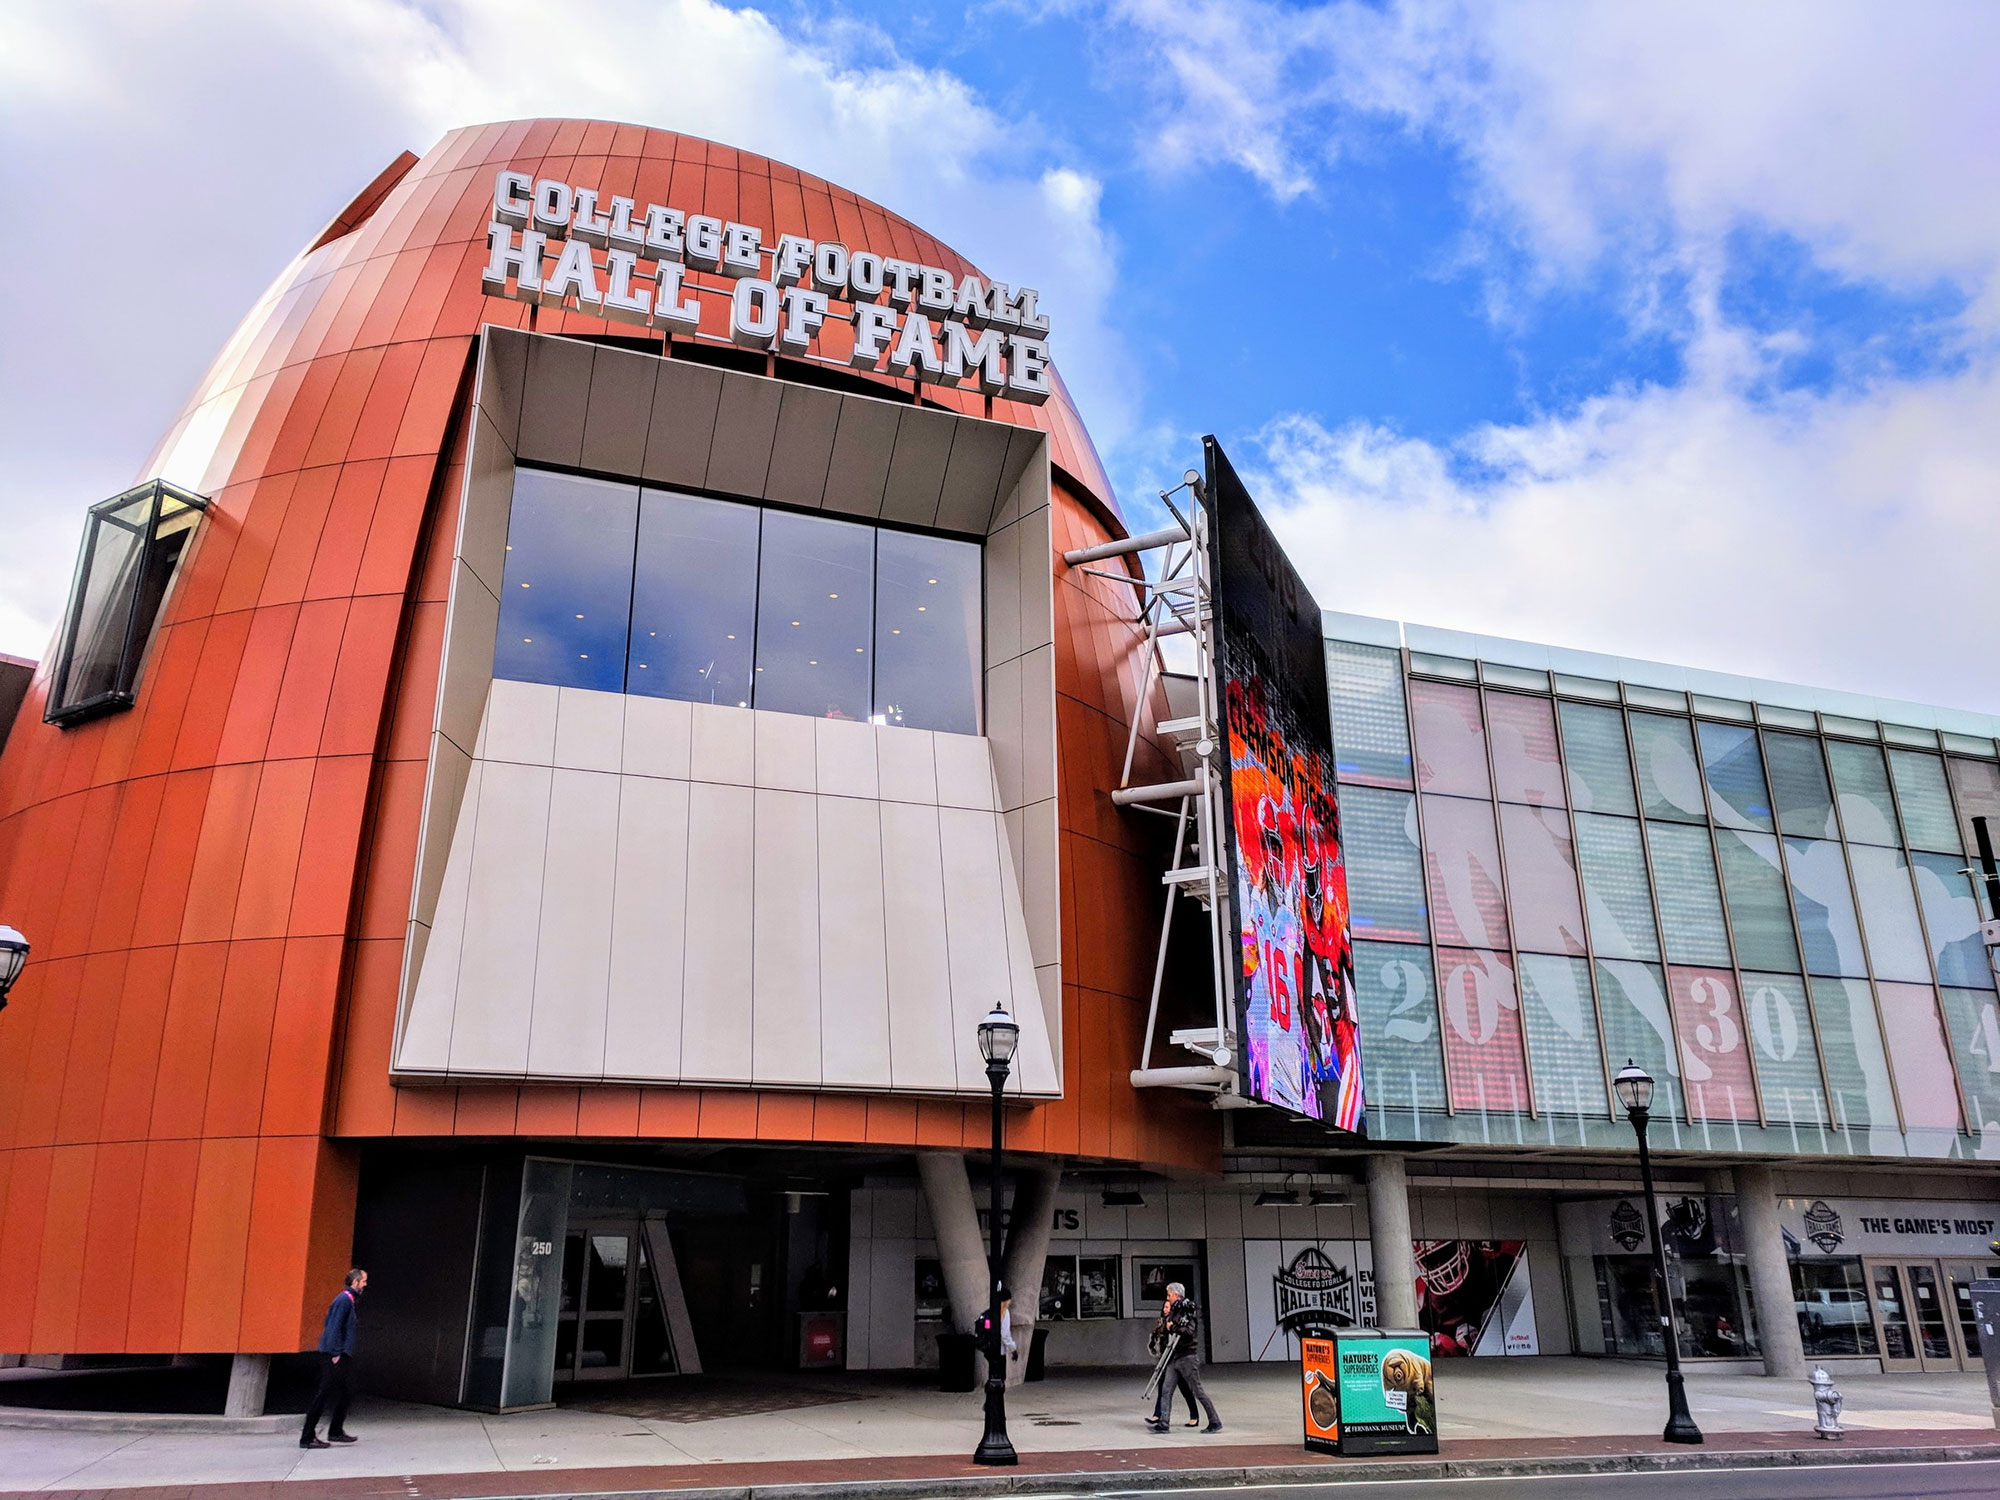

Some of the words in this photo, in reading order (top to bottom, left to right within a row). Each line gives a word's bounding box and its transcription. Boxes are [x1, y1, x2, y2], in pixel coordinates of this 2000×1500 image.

[494, 169, 761, 277] COLLEGE
[775, 232, 1051, 339] FOOTBALL
[482, 220, 701, 337] HALL
[730, 277, 828, 357] OF
[850, 299, 1051, 406] FAME
[1228, 689, 1296, 796] CLEMSON
[1297, 769, 1340, 843] TIGERS
[1264, 939, 1291, 1033] 16
[1380, 959, 1499, 1045] 20
[1690, 976, 1799, 1062] 30
[1860, 1218, 1892, 1234] THE
[1893, 1218, 1951, 1234] GAME'S
[1953, 1219, 1994, 1235] MOST
[532, 1242, 552, 1255] 250
[1284, 1275, 1312, 1288] COLLEGE
[1312, 1276, 1343, 1288] FOOTBALL
[1279, 1285, 1311, 1316] HALL
[1319, 1285, 1351, 1315] FAME
[1362, 1301, 1374, 1313] IS
[1343, 1353, 1379, 1364] NATURE'S
[1343, 1364, 1379, 1375] SUPERHEROES
[1351, 1425, 1380, 1433] FERNBANK
[1381, 1424, 1404, 1432] MUSEUM
